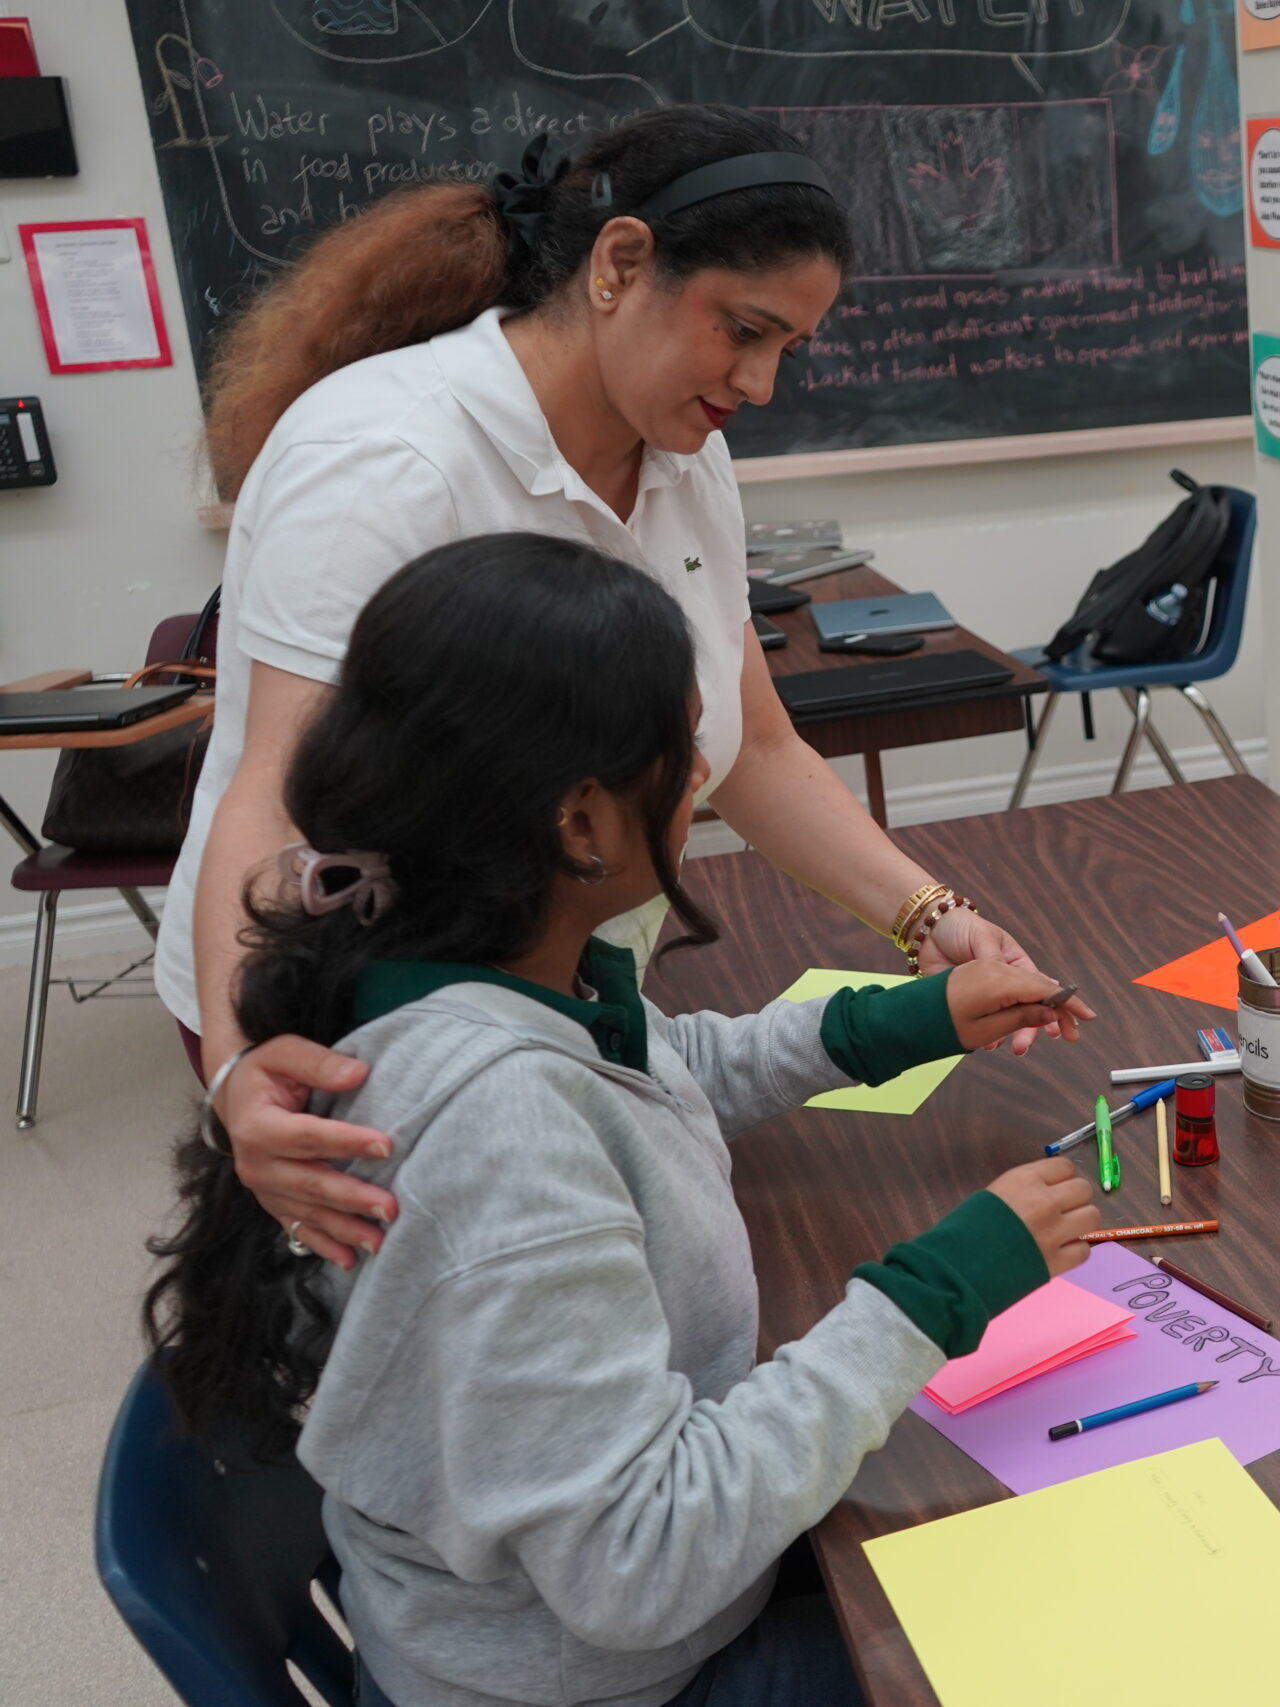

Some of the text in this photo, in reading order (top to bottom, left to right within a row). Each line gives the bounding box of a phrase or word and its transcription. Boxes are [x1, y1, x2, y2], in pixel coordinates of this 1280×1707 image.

[231, 91, 329, 142] Water
[368, 105, 457, 155] plays
[503, 90, 592, 136] direct
[241, 146, 499, 202] in food production
[1115, 1227, 1155, 1237] CHARCOAL
